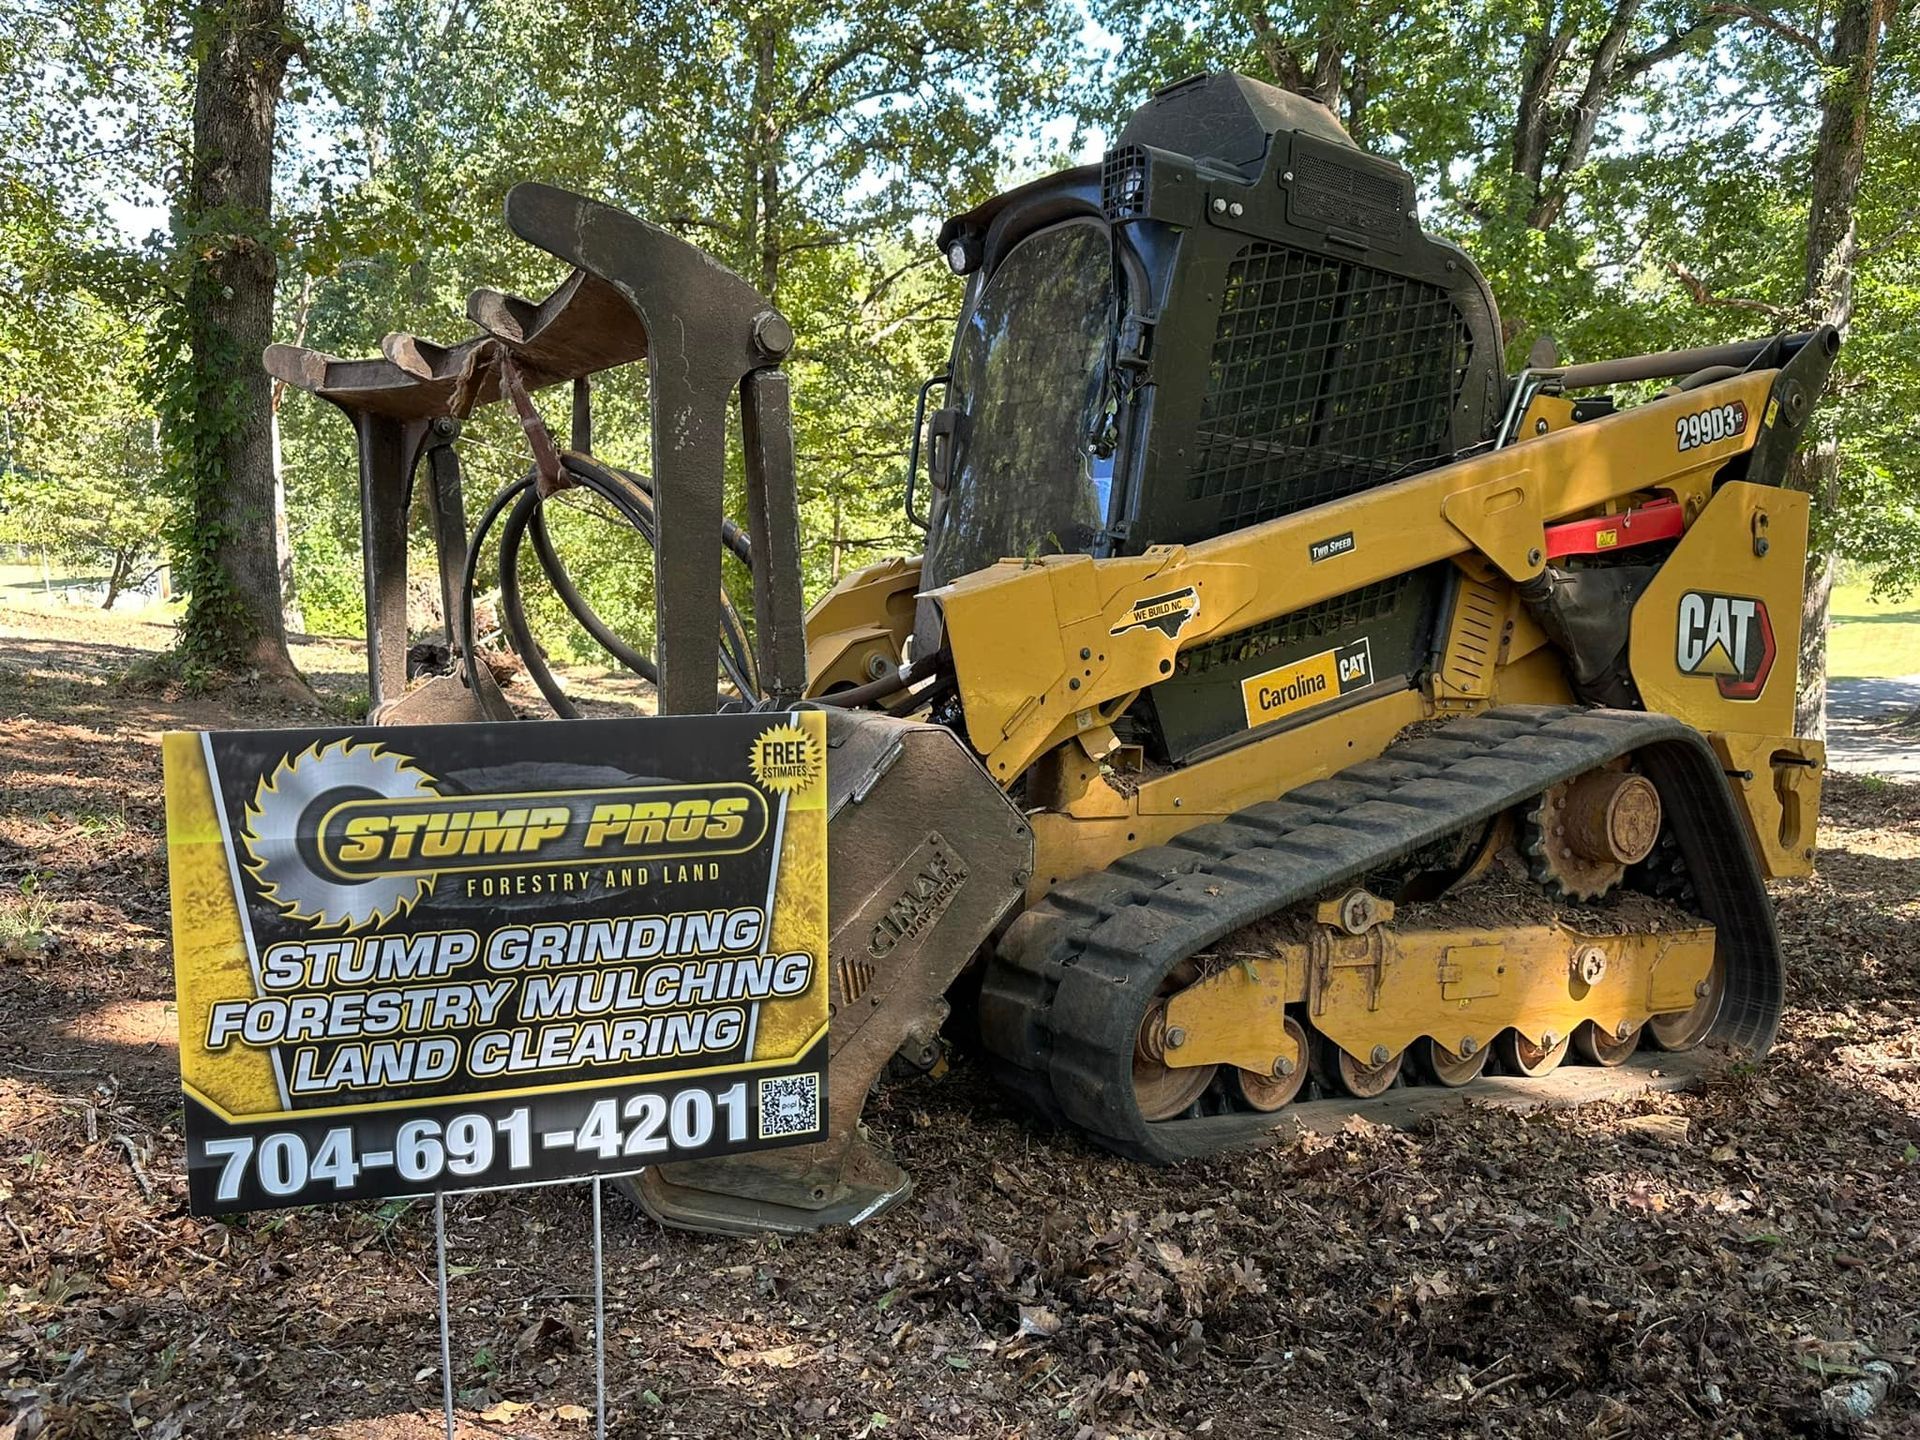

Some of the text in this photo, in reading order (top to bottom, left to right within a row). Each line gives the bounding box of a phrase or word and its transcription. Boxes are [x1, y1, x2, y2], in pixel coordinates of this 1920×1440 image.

[1677, 405, 1735, 450] 299D3
[1133, 600, 1182, 621] WE BUILD NC
[1677, 592, 1755, 682] CAT
[1259, 652, 1365, 710] Carolina CAT
[762, 740, 806, 765] FREE
[762, 765, 807, 778] ESTIMATES
[338, 797, 749, 862] STUMP PROS
[466, 862, 721, 898] FORESTRY AND LAND
[869, 851, 948, 958] CIMAF
[266, 910, 761, 986] STUMP GRINDING
[209, 956, 809, 1045] FORESTRY MULCHING
[294, 1012, 743, 1091] LAND CLEARING
[205, 1082, 749, 1200] 704-691-4201
